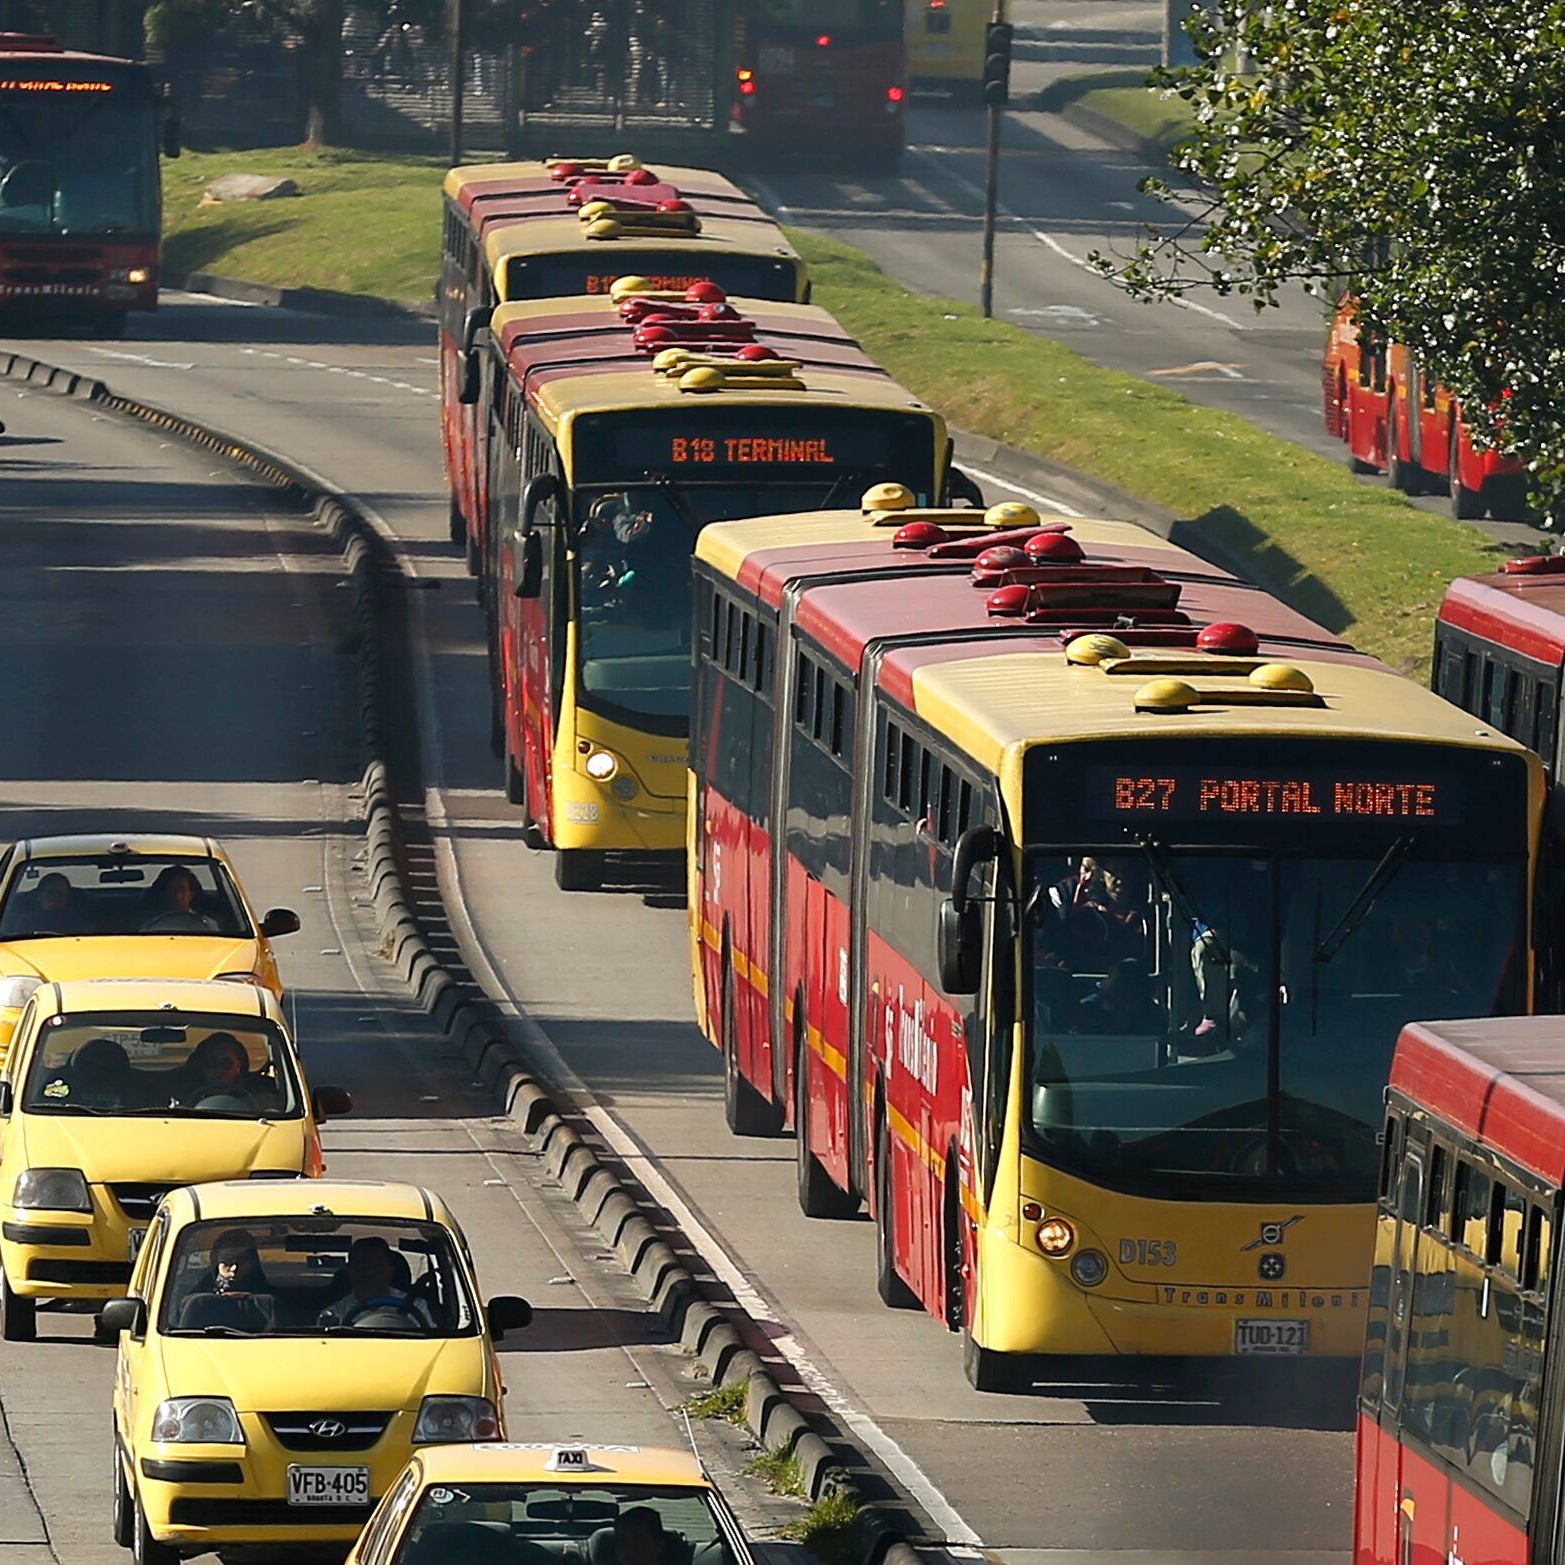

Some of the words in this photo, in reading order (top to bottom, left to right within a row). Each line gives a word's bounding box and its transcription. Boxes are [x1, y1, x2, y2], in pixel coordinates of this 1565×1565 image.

[724, 439, 834, 463] TERMINAL
[1115, 777, 1176, 811] B27
[1199, 779, 1322, 813] PORTAL
[1334, 782, 1435, 816] NORTE
[1118, 1238, 1178, 1267] D153
[1164, 1287, 1359, 1308] TransMileni
[557, 1452, 583, 1465] TAXI
